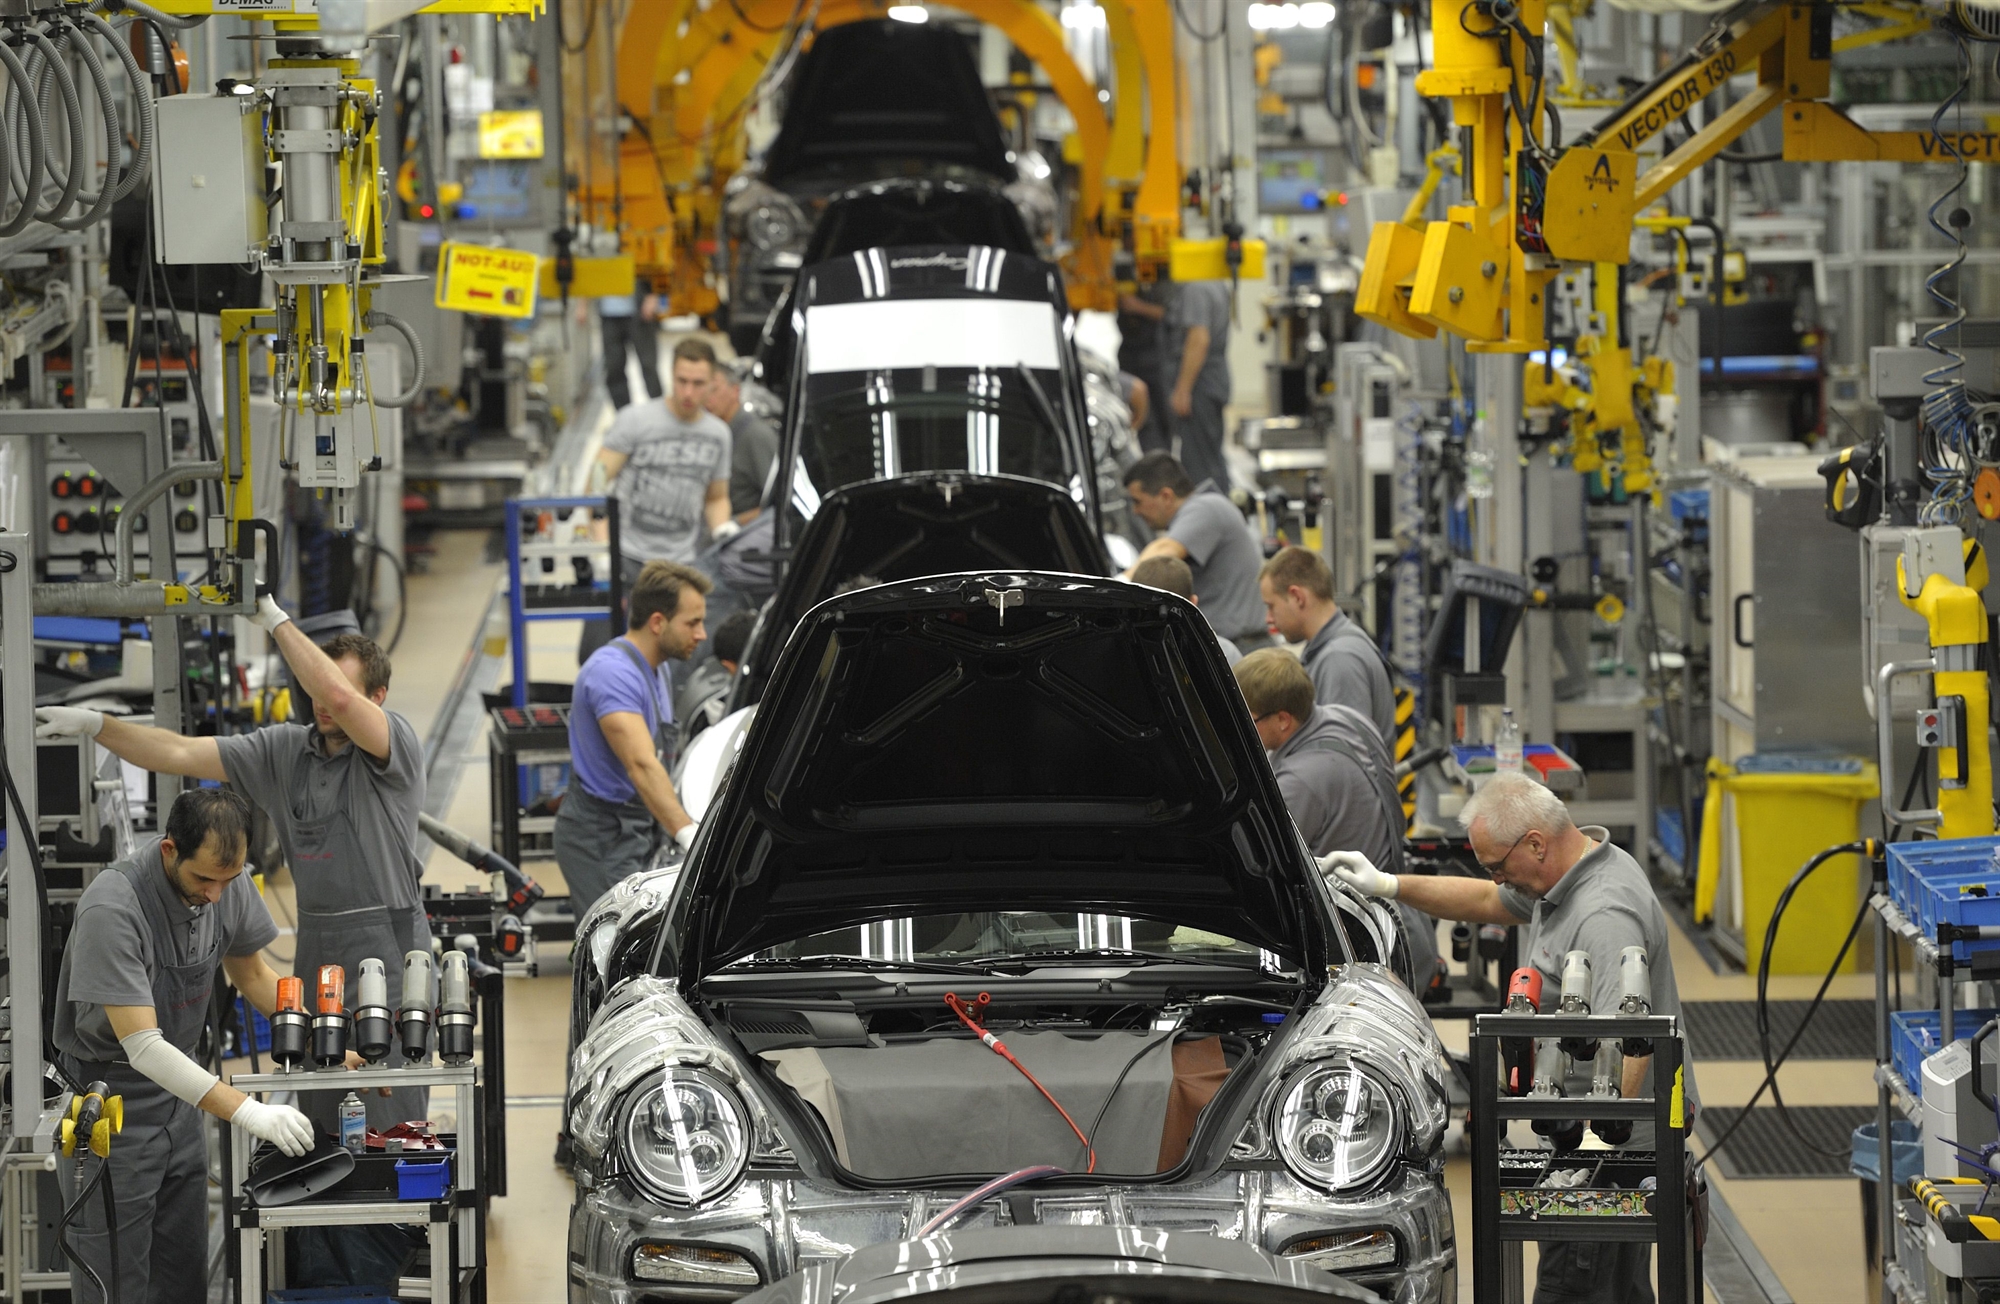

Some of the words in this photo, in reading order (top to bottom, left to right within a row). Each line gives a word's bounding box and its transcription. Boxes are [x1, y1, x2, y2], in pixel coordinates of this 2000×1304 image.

[1618, 77, 1701, 150] VECTOR
[1703, 51, 1736, 87] 130
[1918, 133, 2000, 157] VECT
